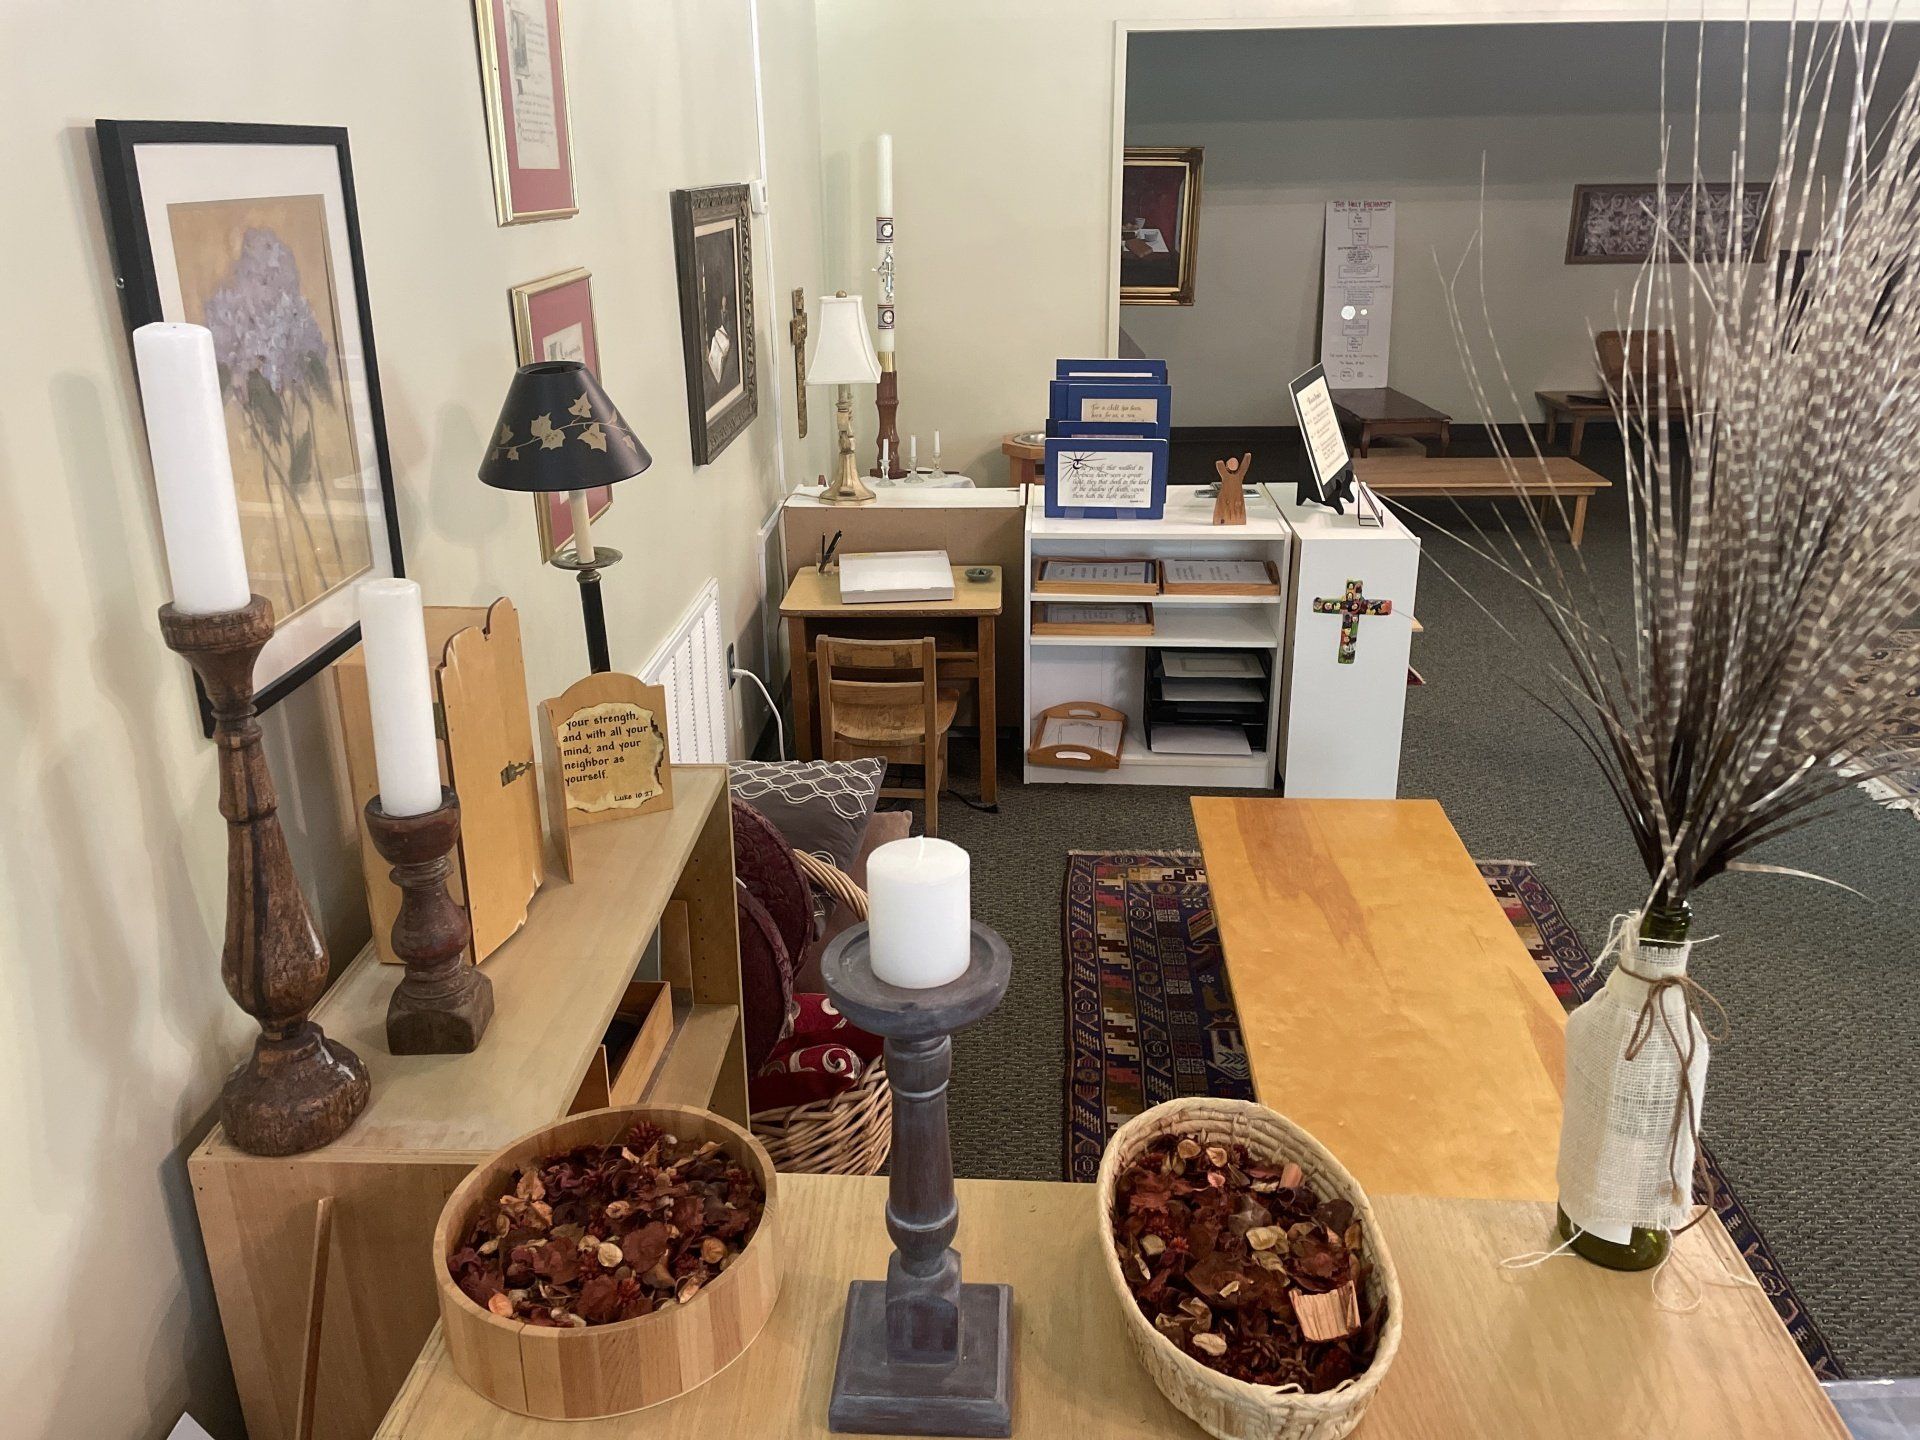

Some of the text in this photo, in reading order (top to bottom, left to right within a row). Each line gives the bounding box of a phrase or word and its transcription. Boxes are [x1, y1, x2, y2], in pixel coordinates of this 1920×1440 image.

[566, 711, 639, 731] your strength,
[562, 725, 649, 743] and with all your
[563, 740, 641, 757] mind; and your
[564, 756, 625, 771] neighbor as
[564, 770, 608, 786] yourself.
